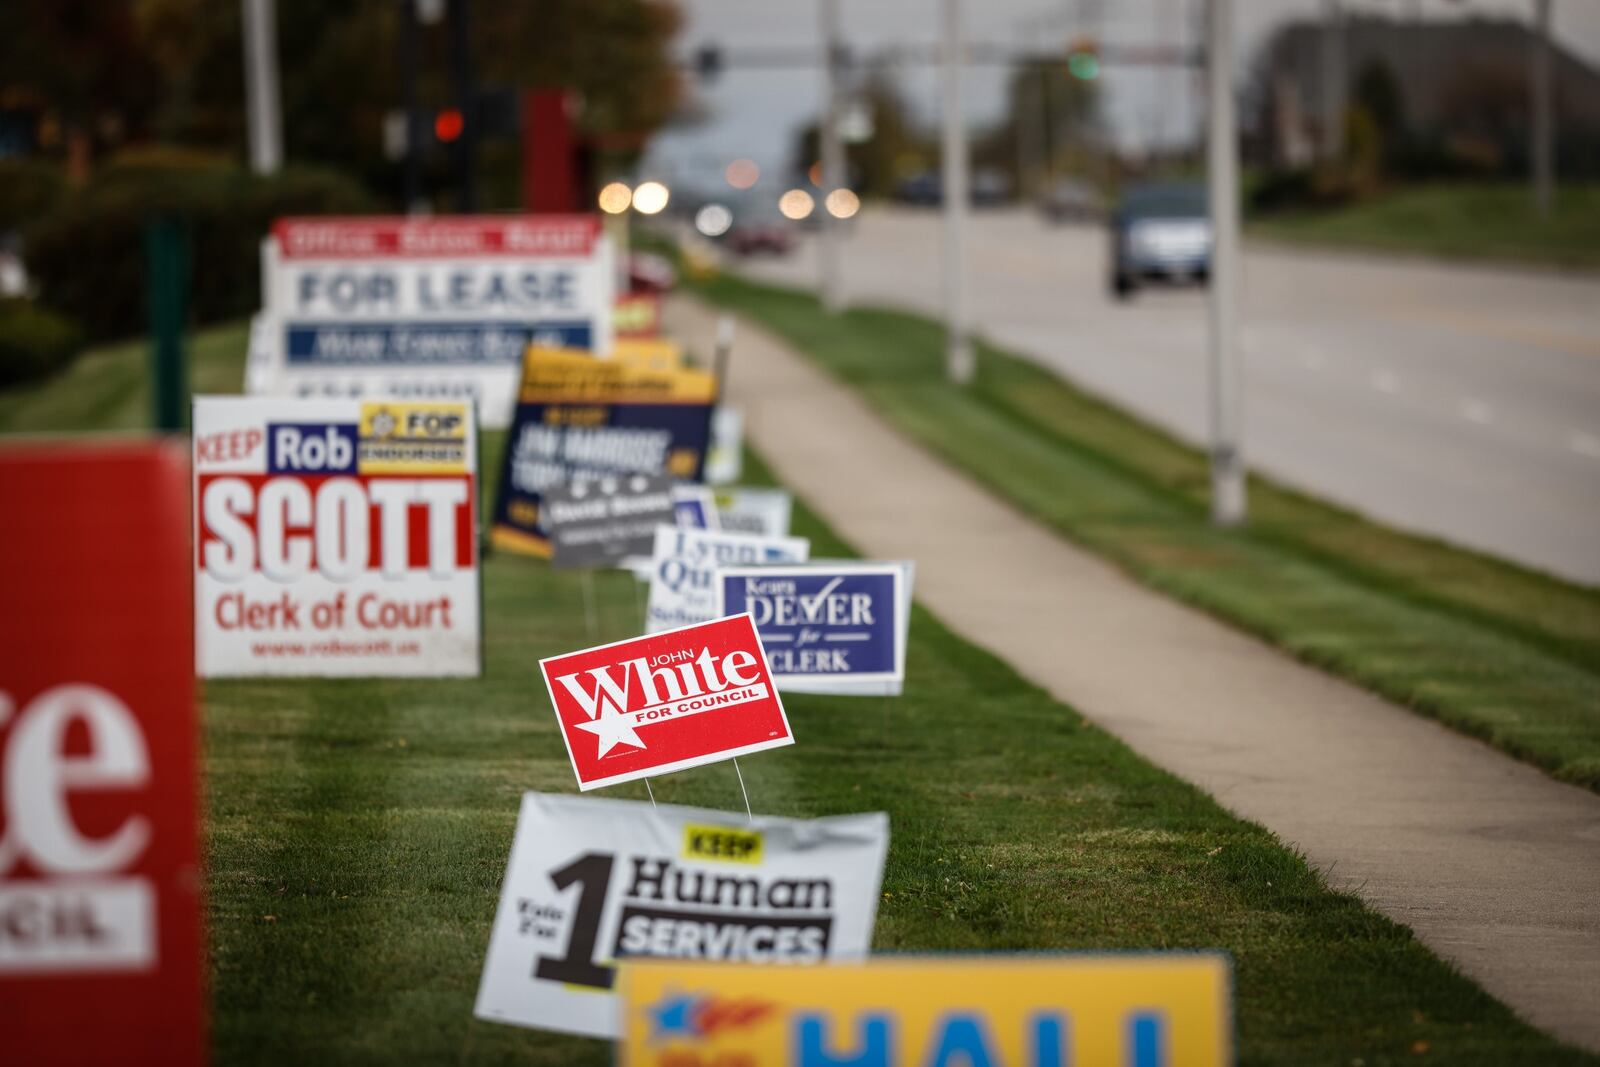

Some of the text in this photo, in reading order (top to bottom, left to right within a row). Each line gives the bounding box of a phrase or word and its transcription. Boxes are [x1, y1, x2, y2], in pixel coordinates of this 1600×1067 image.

[298, 270, 578, 308] FOR LEASE
[405, 413, 465, 432] FOP
[195, 426, 354, 472] KEEP Rob
[360, 446, 464, 461] ENDORSED
[202, 476, 469, 582] SCOTT
[214, 591, 453, 631] Clerk of Court
[649, 649, 694, 668] JOHN
[768, 649, 850, 672] CLERK
[555, 646, 760, 720] White
[635, 688, 759, 723] FOR COUNCIL
[690, 833, 758, 860] KEEP
[626, 857, 832, 909] Human
[534, 850, 616, 989] 1
[621, 915, 826, 964] SERVICES
